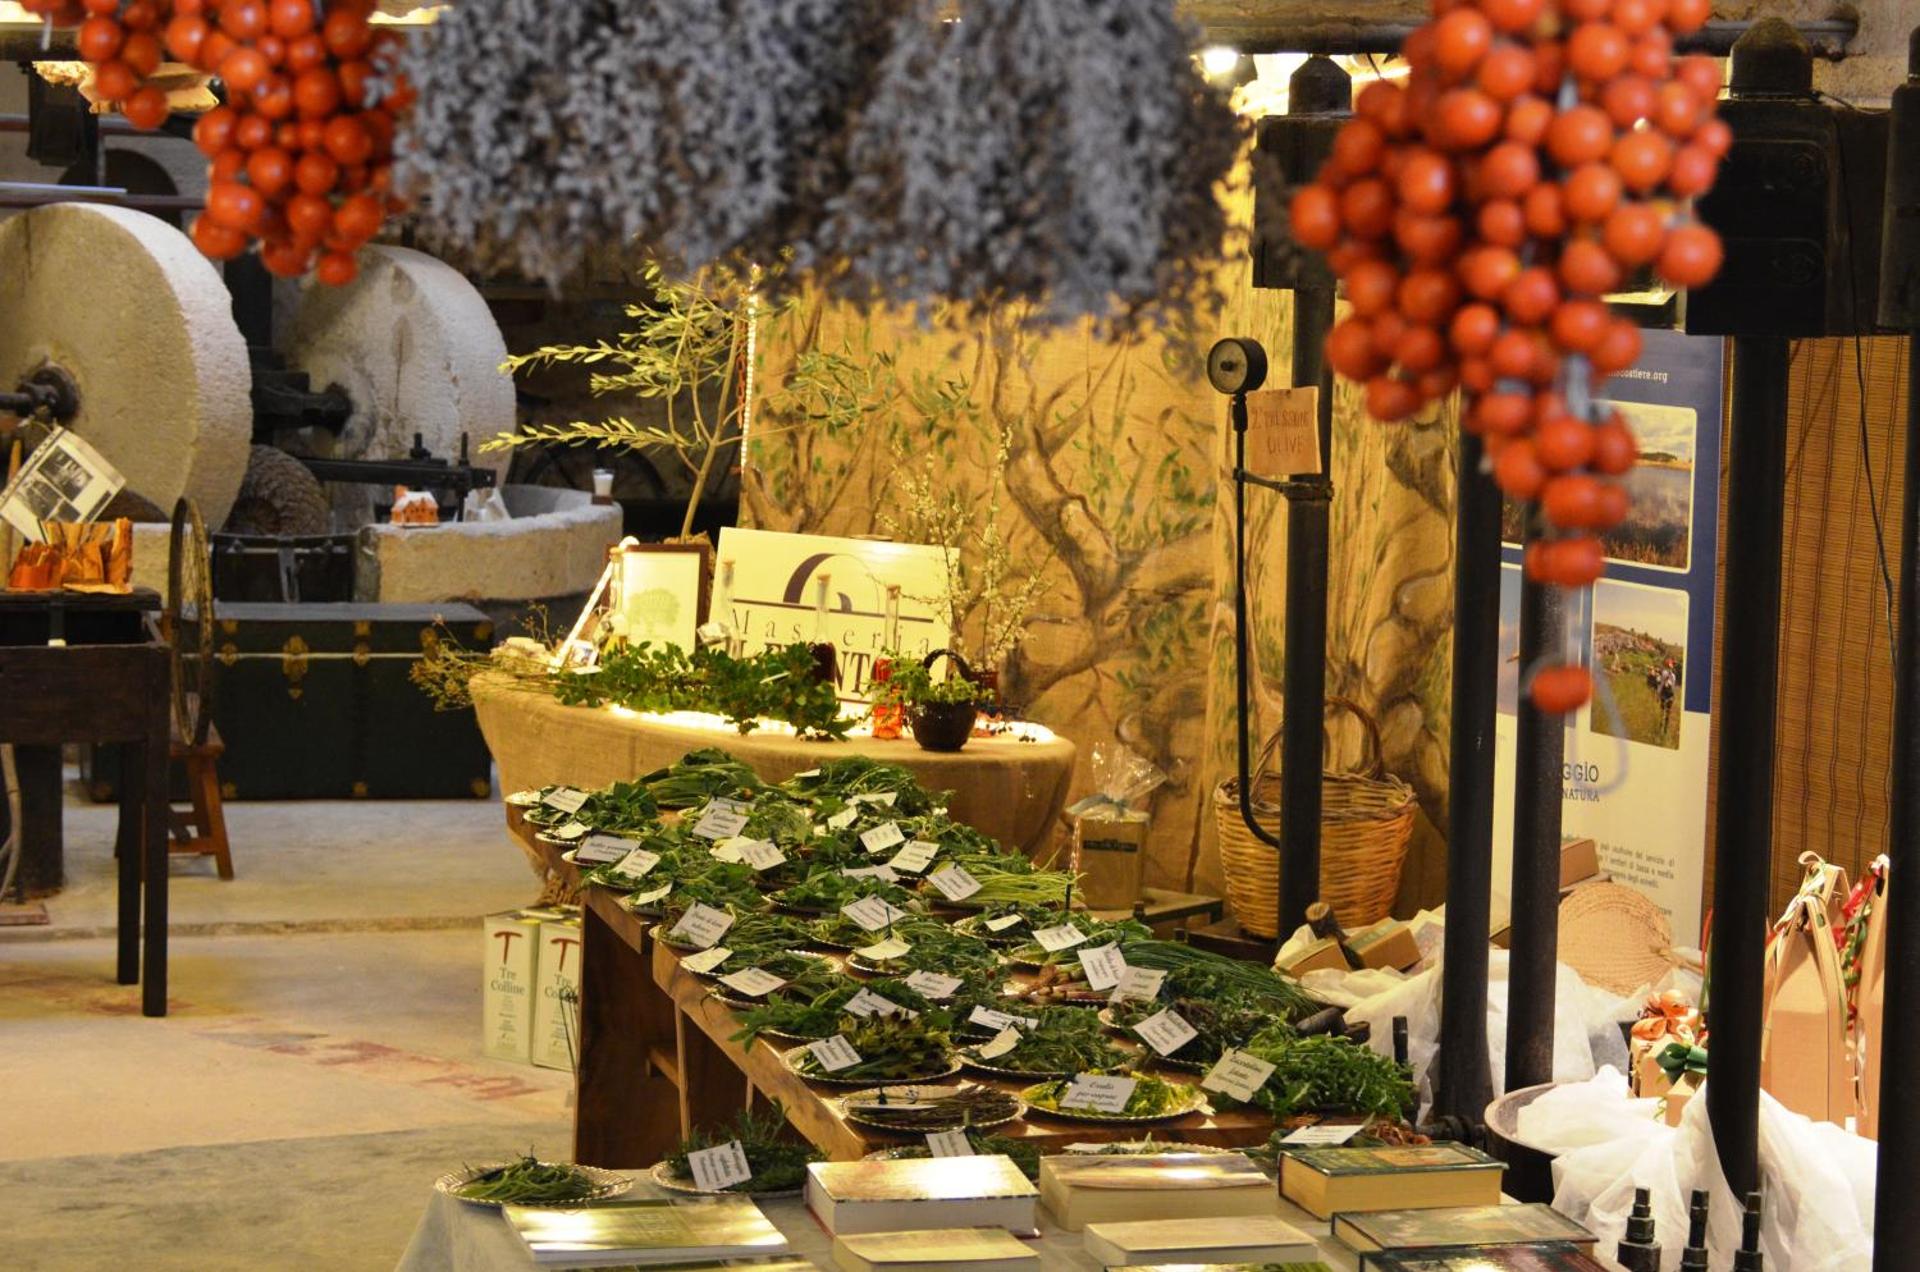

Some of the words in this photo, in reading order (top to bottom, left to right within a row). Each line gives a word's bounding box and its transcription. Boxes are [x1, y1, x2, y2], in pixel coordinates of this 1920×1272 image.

[732, 607, 930, 654] Maseria
[499, 966, 518, 980] Tre
[554, 973, 573, 986] Tre
[490, 979, 526, 996] Colline
